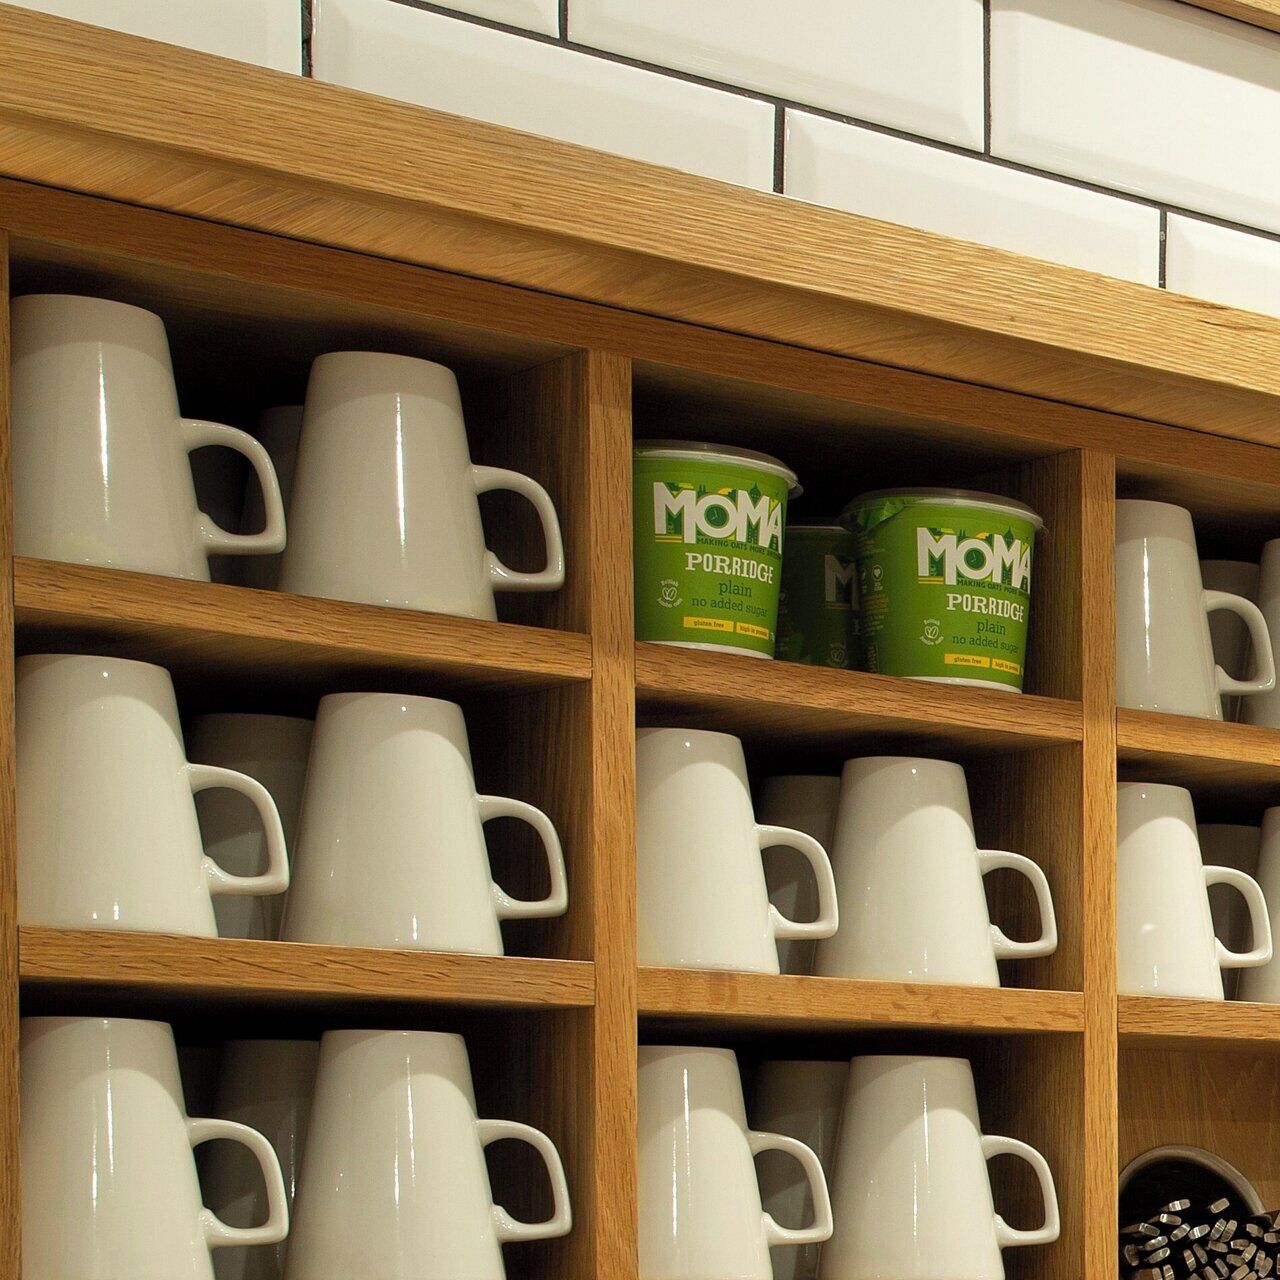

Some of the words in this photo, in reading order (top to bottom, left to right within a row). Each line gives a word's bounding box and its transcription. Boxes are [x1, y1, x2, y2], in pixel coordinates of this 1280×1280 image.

[654, 482, 782, 553] MOMA
[697, 538, 729, 548] MAKING
[685, 553, 773, 584] PORRIDGE
[917, 528, 1030, 594] MOMA
[719, 580, 752, 597] plain
[957, 578, 985, 588] MAKING
[692, 598, 706, 607] no
[711, 598, 743, 611] added
[745, 604, 768, 617] sugar
[946, 594, 1024, 622] PORRIDGE
[694, 620, 712, 628] gluten
[977, 619, 1006, 635] plain
[953, 636, 966, 644] no
[969, 635, 998, 648] added
